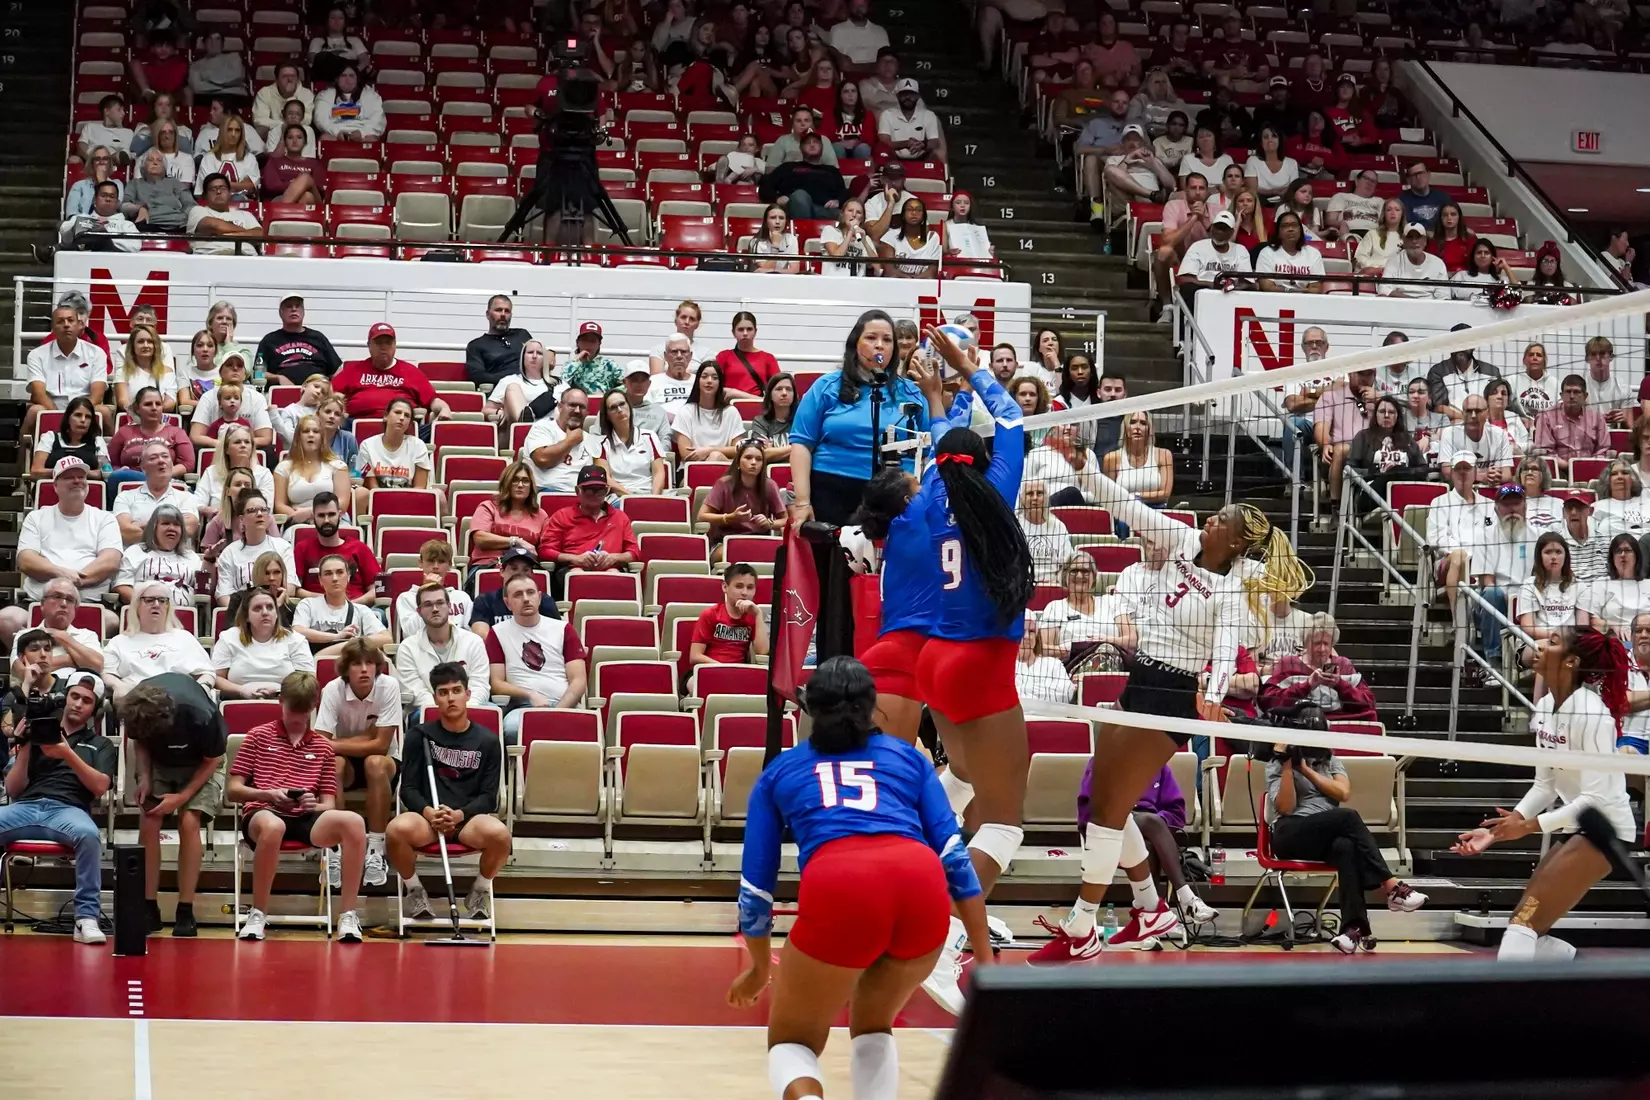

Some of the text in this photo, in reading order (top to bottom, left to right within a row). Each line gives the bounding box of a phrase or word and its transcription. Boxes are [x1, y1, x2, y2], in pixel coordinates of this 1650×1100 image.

[904, 35, 916, 44] 21
[2, 55, 15, 64] 19
[916, 61, 931, 70] 20
[904, 80, 912, 88] A
[936, 87, 948, 98] 19
[949, 116, 961, 125] 18
[1578, 131, 1601, 150] EXIT
[965, 144, 977, 155] 17
[982, 176, 995, 187] 16
[1000, 208, 1013, 218] 15
[1019, 239, 1033, 250] 14
[1041, 273, 1055, 284] 13
[89, 268, 170, 336] M
[1083, 341, 1095, 352] 11
[1233, 307, 1295, 386] N
[359, 373, 405, 387] ARKANSAS
[664, 387, 686, 395] CBU
[941, 539, 962, 590] 9
[1165, 582, 1190, 608] 3
[813, 760, 878, 812] 15
